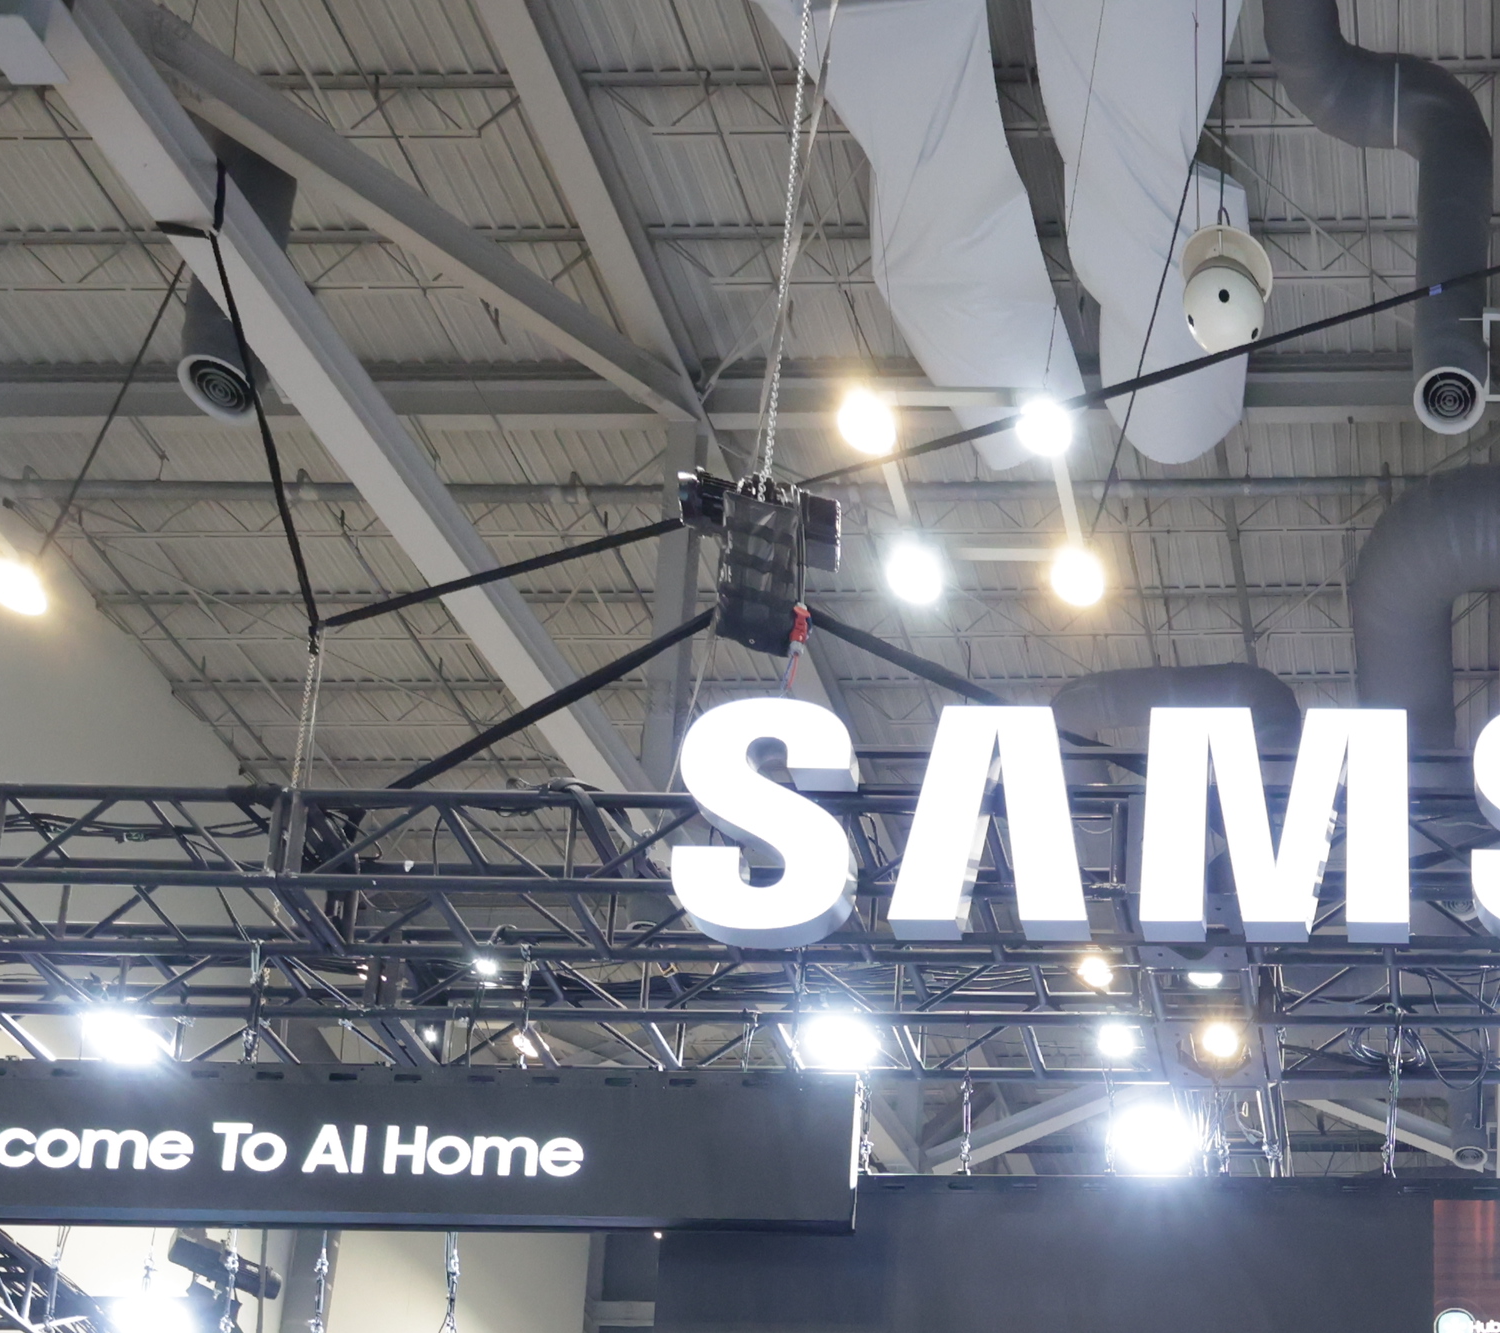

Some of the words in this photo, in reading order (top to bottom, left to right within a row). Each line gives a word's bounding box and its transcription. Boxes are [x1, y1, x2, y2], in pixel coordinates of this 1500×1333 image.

[212, 1122, 287, 1172] To
[302, 1124, 367, 1175] AI
[383, 1125, 584, 1177] Home
